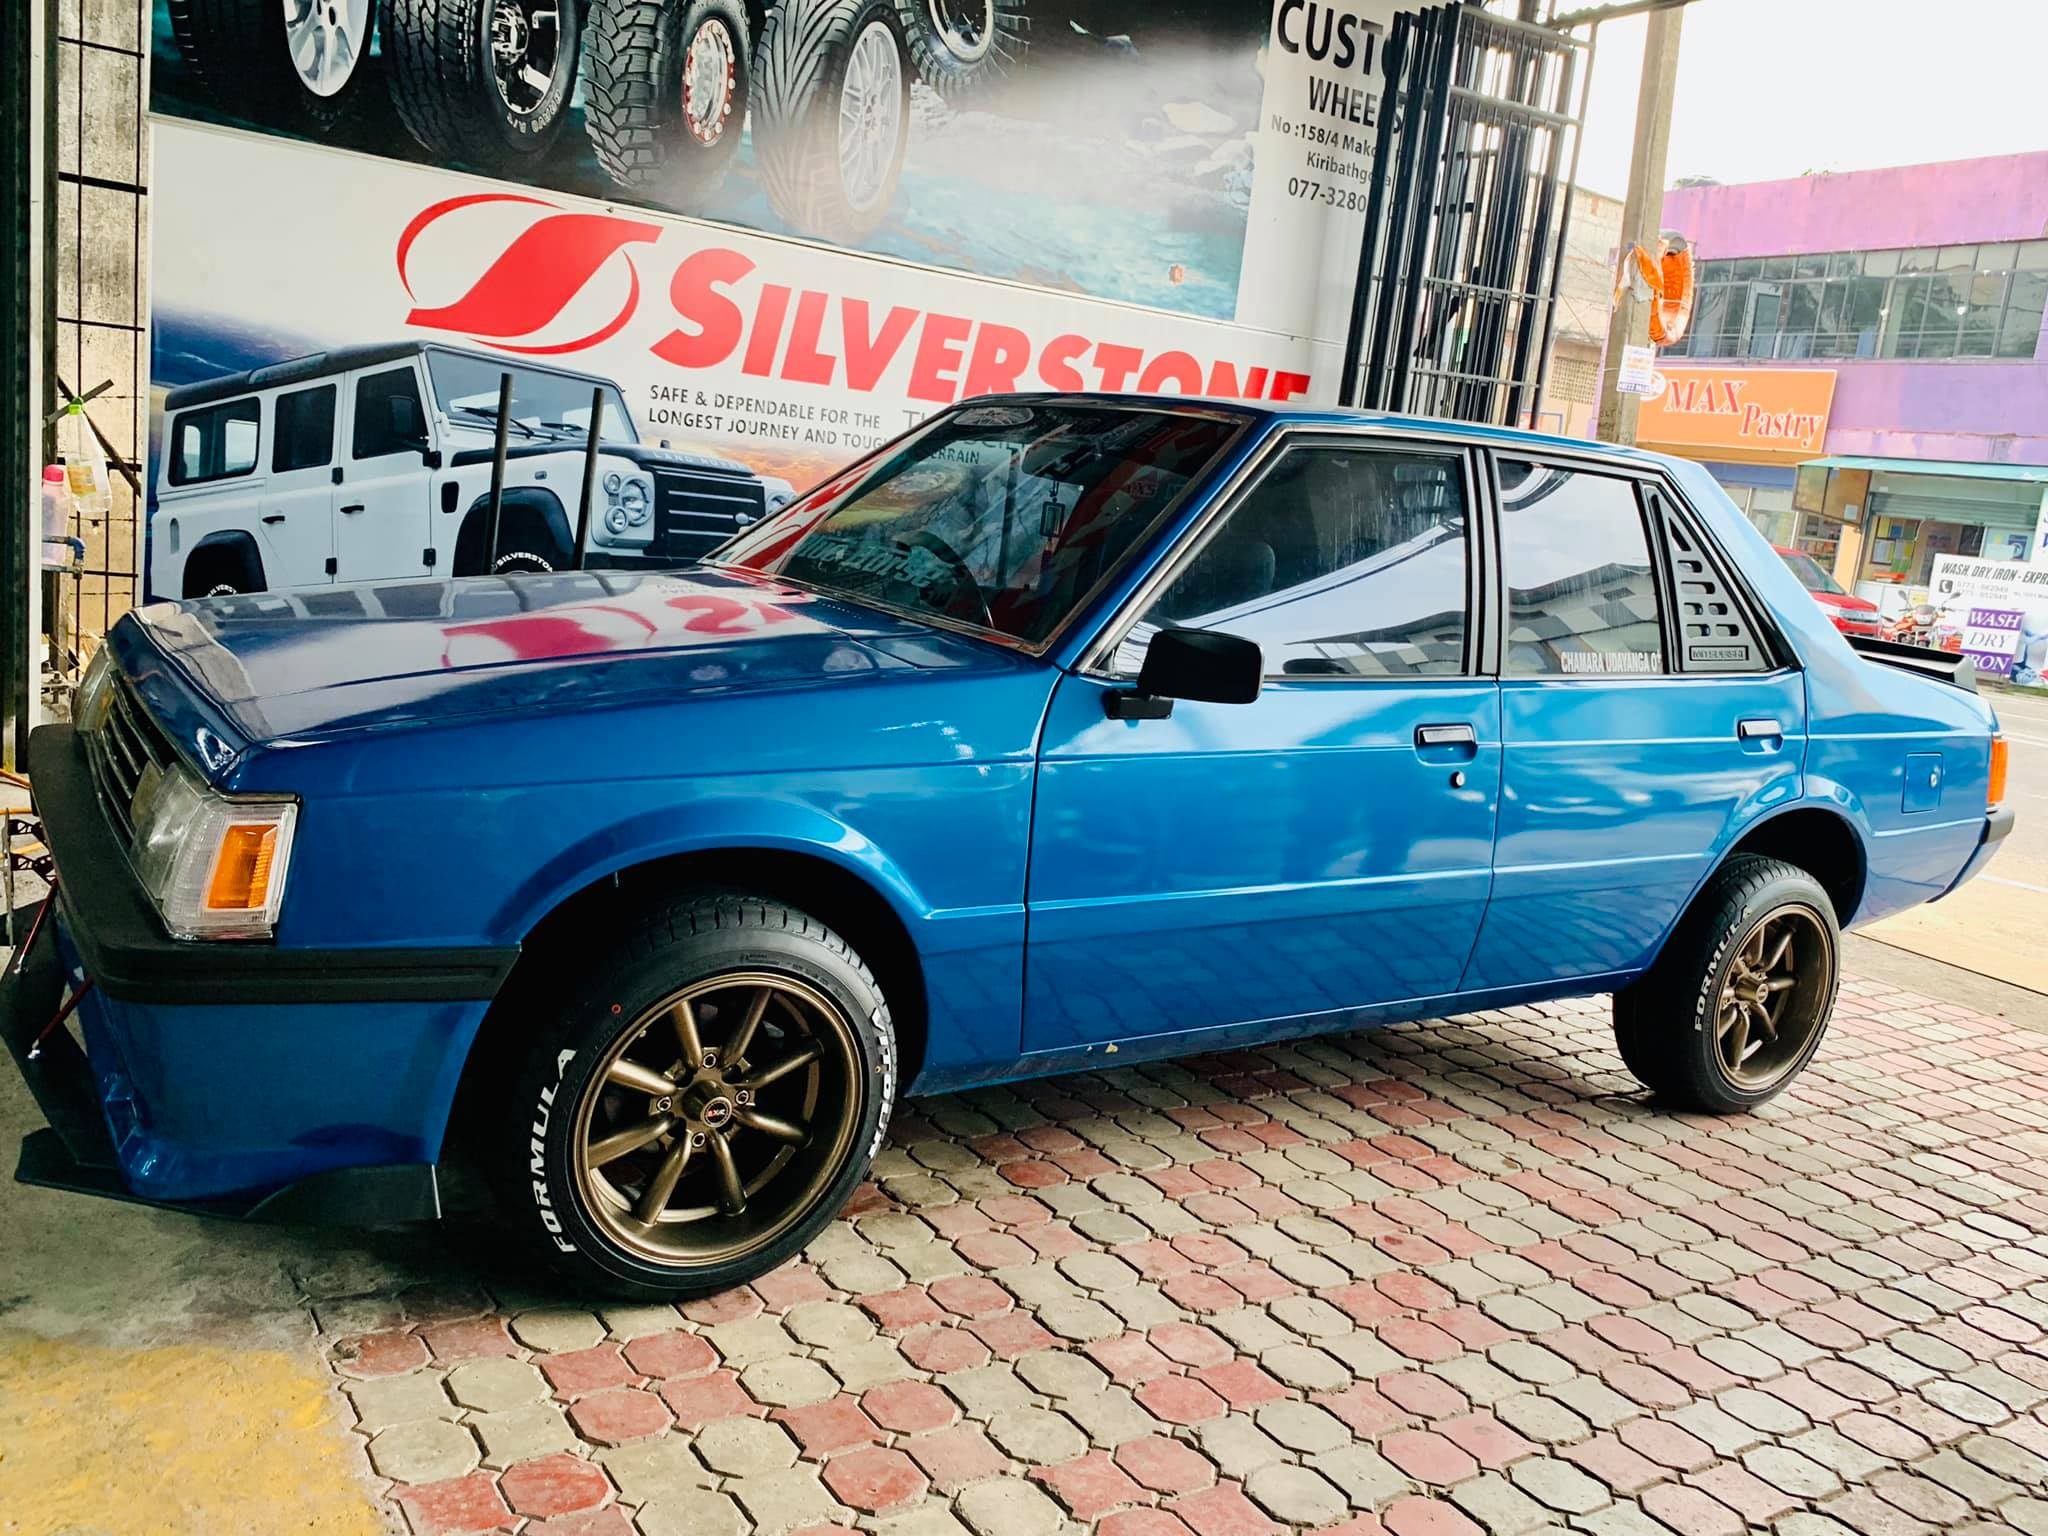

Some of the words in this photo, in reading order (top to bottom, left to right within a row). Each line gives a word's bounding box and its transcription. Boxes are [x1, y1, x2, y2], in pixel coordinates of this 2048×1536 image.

[1272, 114, 1291, 134] No
[1342, 134, 1377, 158] Mako
[650, 384, 689, 404] SAFE
[695, 391, 708, 407] &
[714, 393, 815, 420] DEPENDABLE
[820, 408, 849, 424] FOR
[853, 412, 881, 429] THE
[1664, 379, 1745, 414] MAX
[648, 407, 723, 431] LONGEST
[727, 417, 800, 441] JOURNEY
[804, 428, 838, 445] AND
[843, 432, 888, 450] TOUG
[1740, 403, 1823, 448] Pastry
[1969, 631, 2011, 648] DRY
[1970, 611, 2019, 629] WASH
[1561, 651, 1605, 673] CHAMARA
[1605, 651, 1650, 673] UDAYANGA
[1694, 904, 1751, 1032] FORMULA
[528, 1048, 577, 1253] FORMULA
